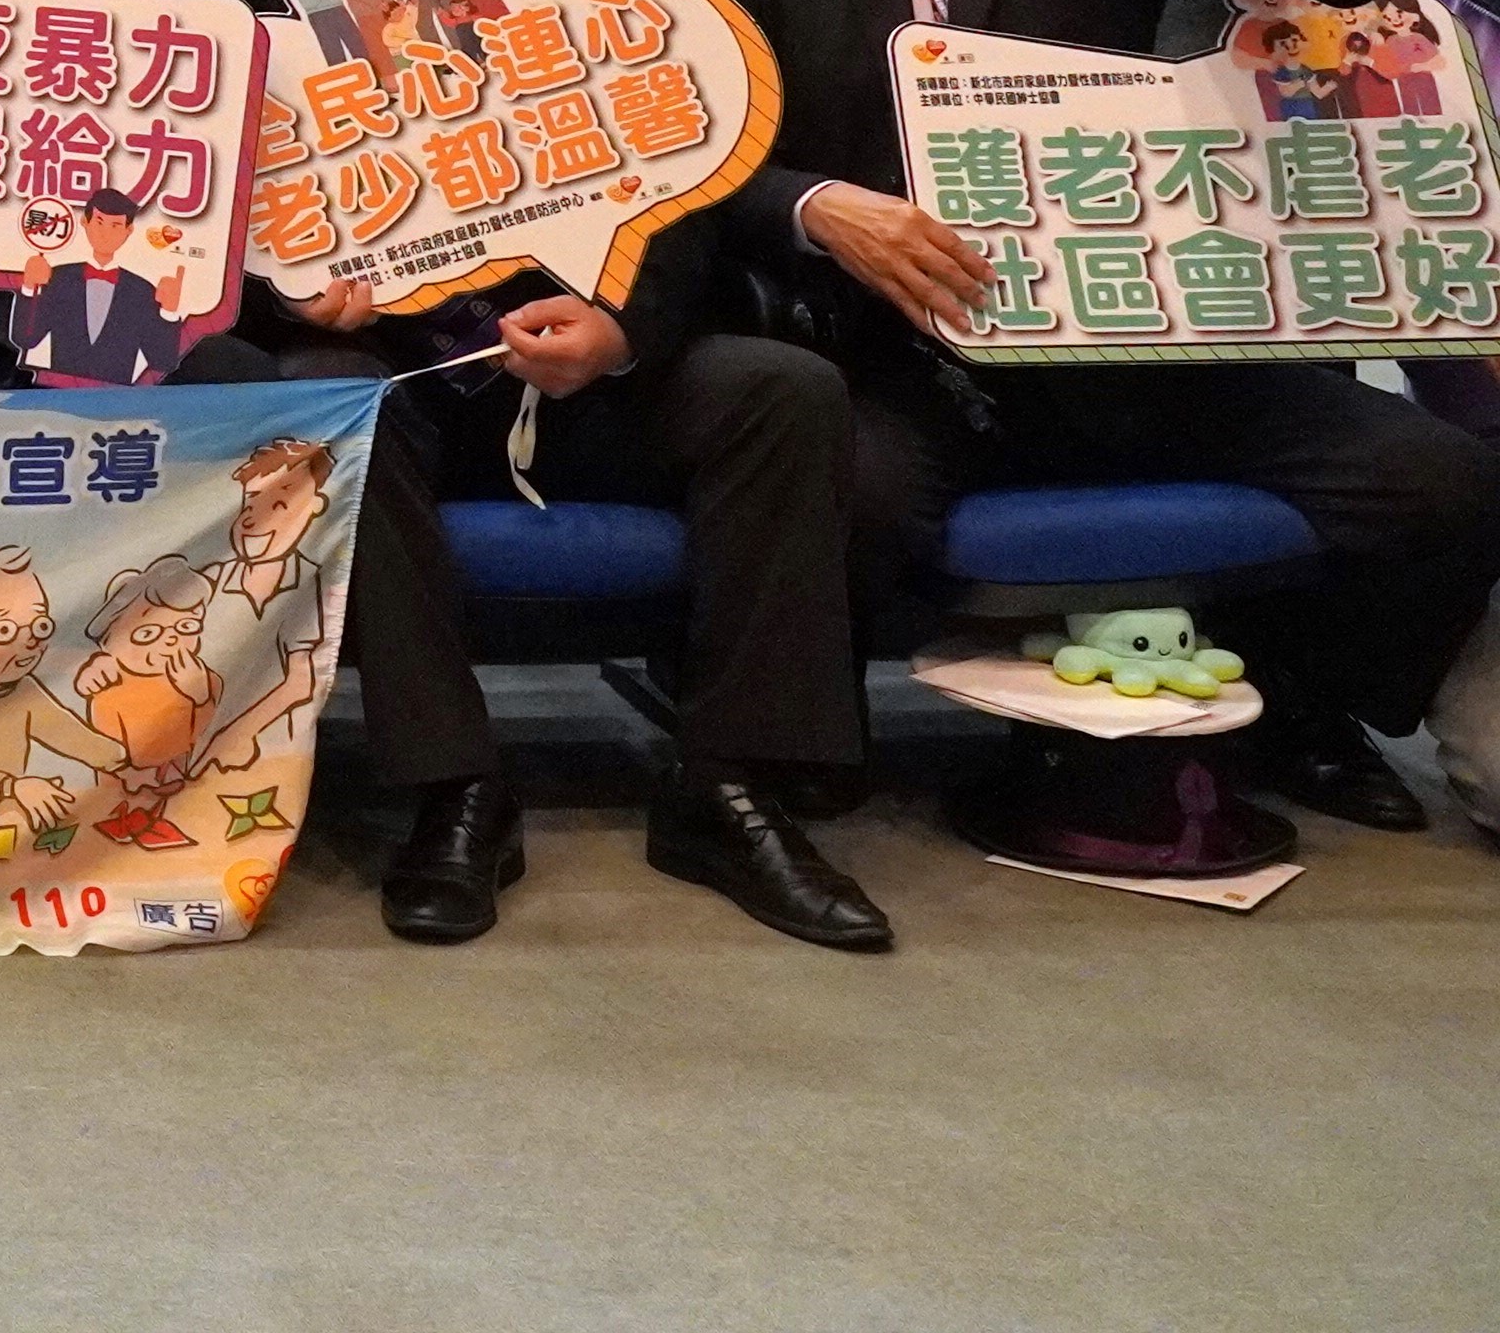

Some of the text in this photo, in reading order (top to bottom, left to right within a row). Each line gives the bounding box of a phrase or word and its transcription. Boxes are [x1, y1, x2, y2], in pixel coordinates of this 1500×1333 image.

[252, 64, 706, 260] 老少都溫馨
[928, 118, 1476, 224] 護老不虐老
[11, 885, 107, 927] 110
[140, 899, 221, 934] 廣告
